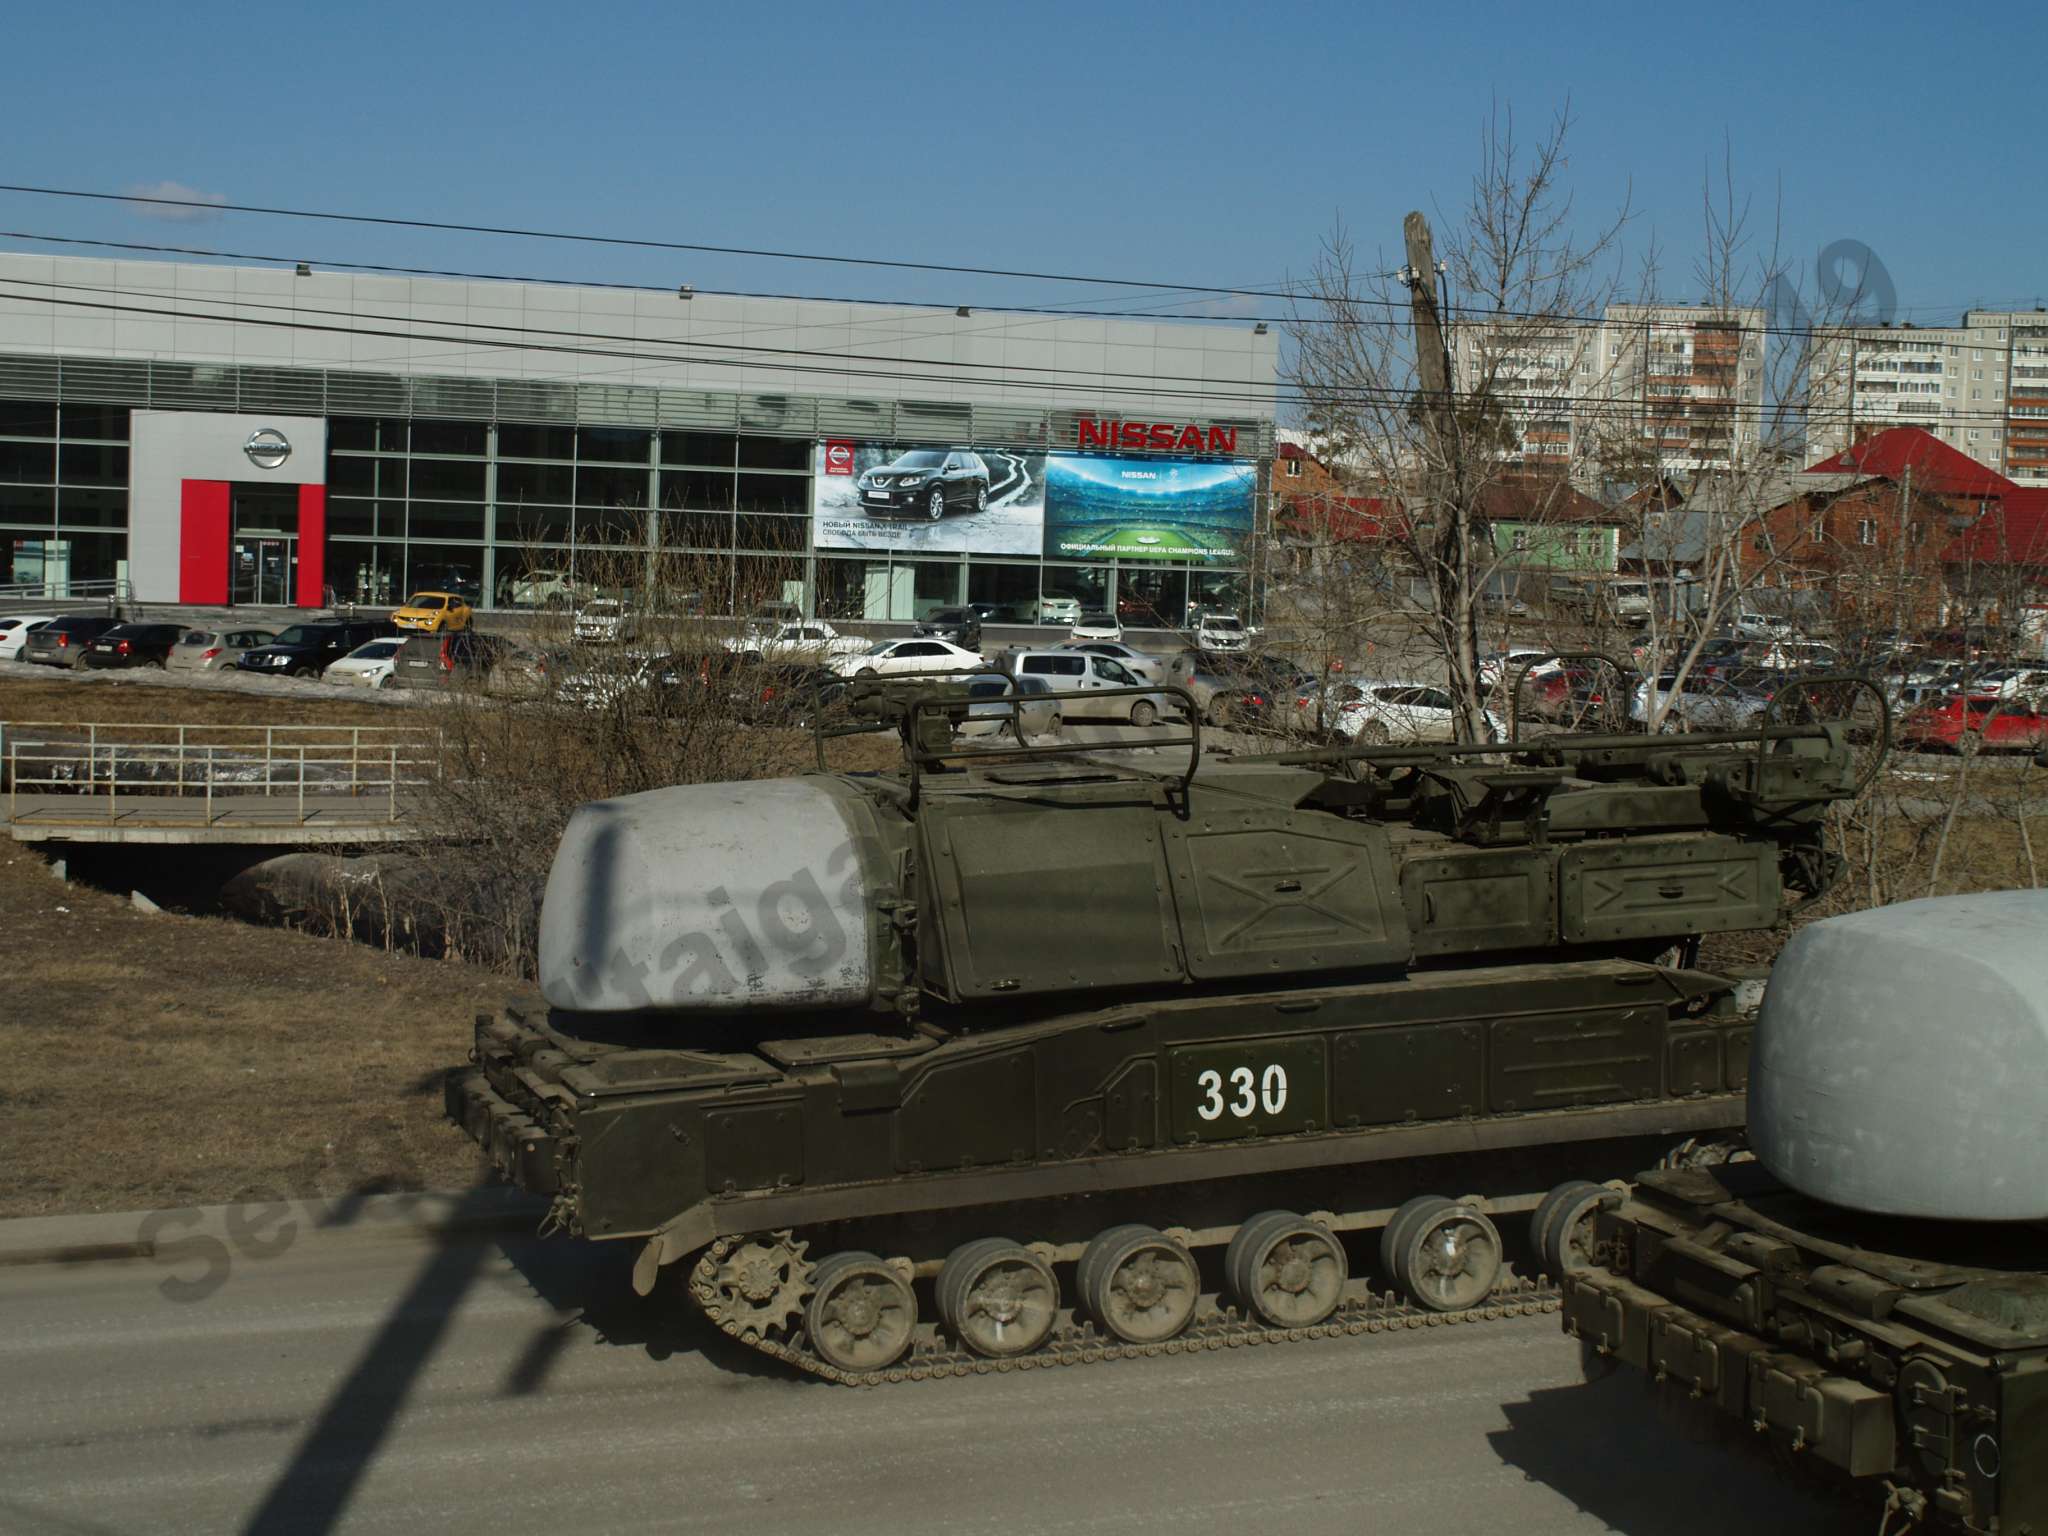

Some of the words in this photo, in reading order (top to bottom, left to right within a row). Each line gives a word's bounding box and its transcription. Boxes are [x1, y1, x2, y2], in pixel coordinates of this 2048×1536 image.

[1078, 419, 1236, 453] NISSAN
[1121, 470, 1157, 480] NISSAN
[822, 519, 851, 529] НОВЫЙ
[1060, 542, 1116, 552] ОФИЦИАЛЬНЫЙ
[1117, 544, 1149, 554] ПАРТНЕР
[1149, 545, 1167, 554] UEFA
[1168, 546, 1208, 555] CHAMPIONS
[1197, 1063, 1288, 1121] 330
